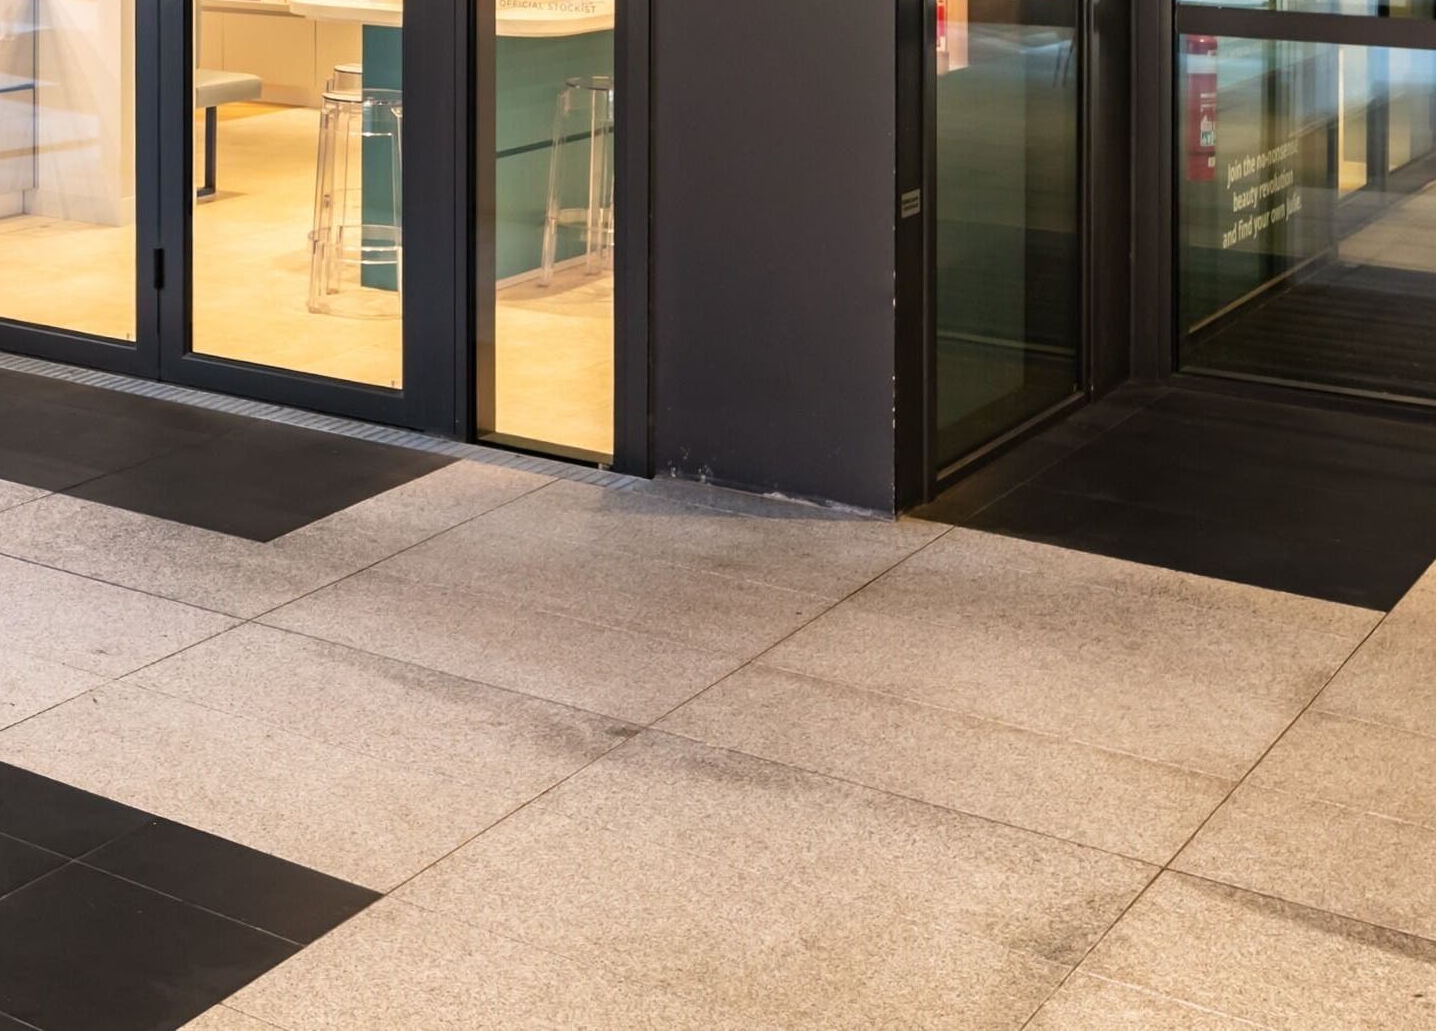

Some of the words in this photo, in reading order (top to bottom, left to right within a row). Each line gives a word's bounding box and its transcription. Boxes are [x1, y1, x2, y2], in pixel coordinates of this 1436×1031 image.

[547, 0, 596, 13] STOCKIST
[1243, 154, 1256, 177] the
[1233, 186, 1259, 213] beauty
[1259, 169, 1294, 199] revolution
[1223, 222, 1237, 250] and
[1238, 215, 1253, 241] find
[1253, 211, 1270, 240] your
[1270, 203, 1286, 224] own
